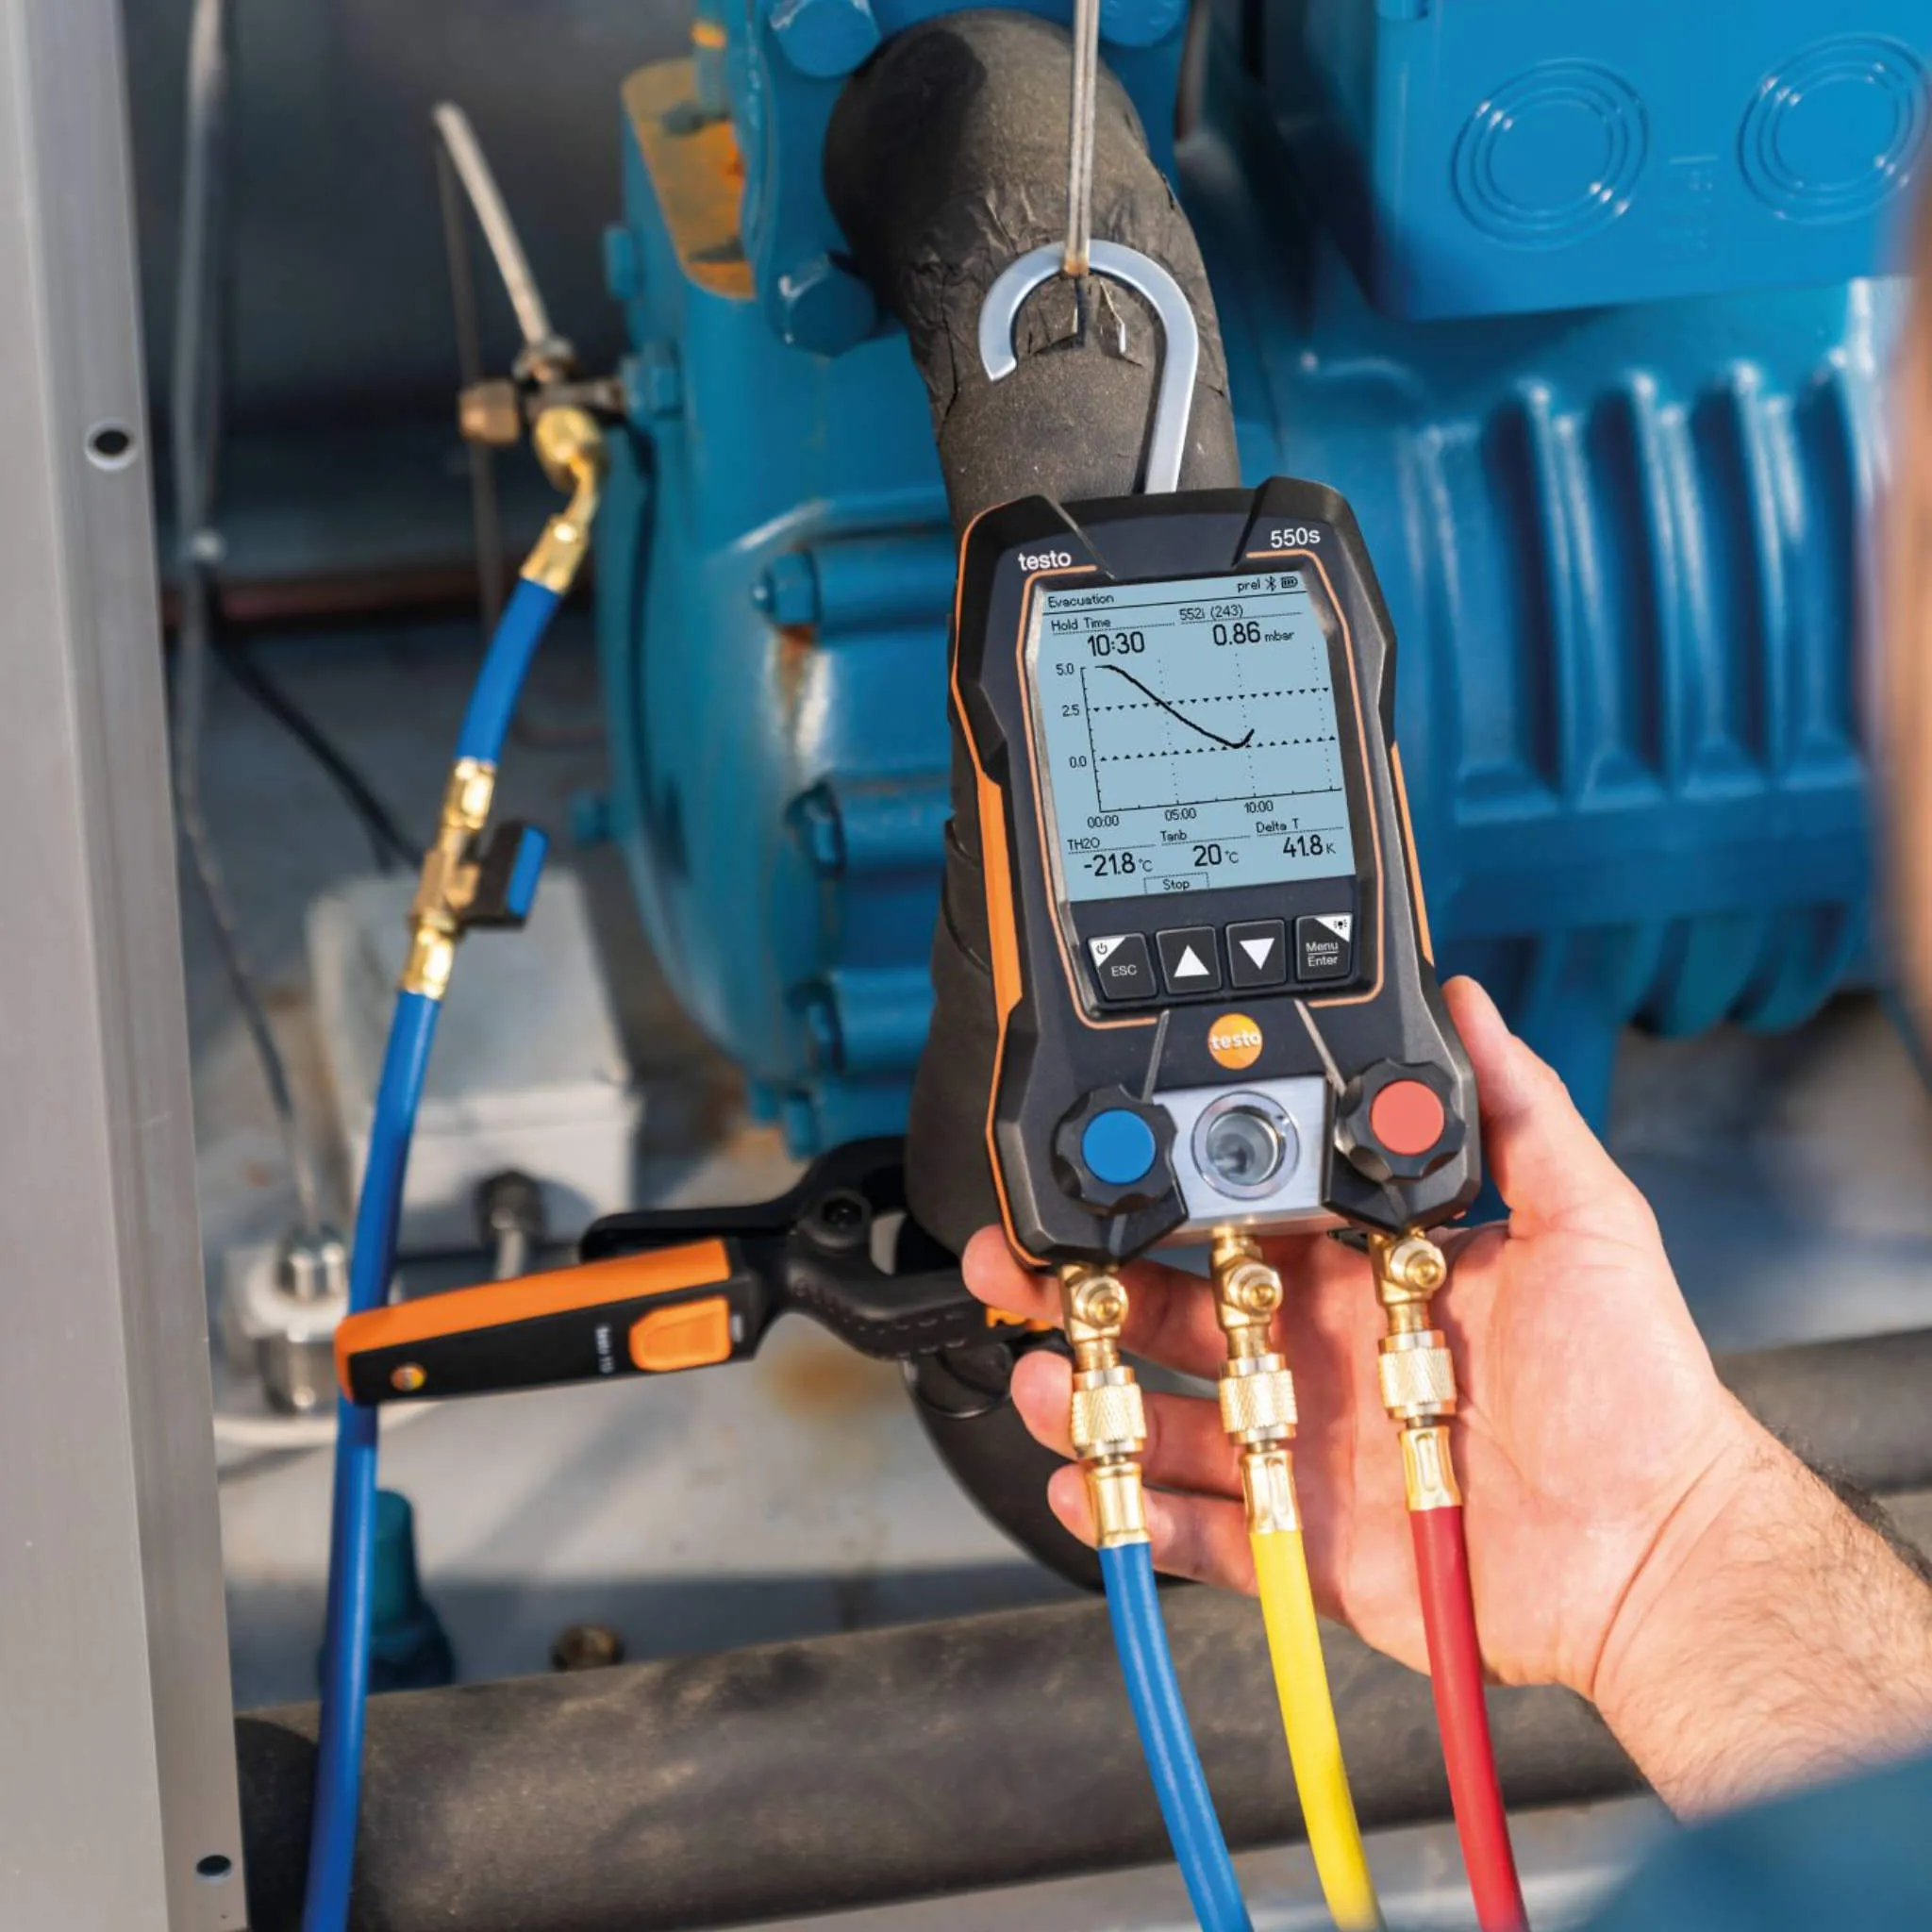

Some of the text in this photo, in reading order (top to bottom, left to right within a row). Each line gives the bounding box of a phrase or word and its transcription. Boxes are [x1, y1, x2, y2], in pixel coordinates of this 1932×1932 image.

[1270, 526, 1321, 548] 550s
[1018, 550, 1072, 572] testo
[1047, 594, 1115, 608] Evacuation
[1209, 604, 1243, 620] (243)
[1051, 617, 1111, 631] Hold Time
[1212, 621, 1295, 646] 0.86 mbar
[1087, 631, 1145, 657] 10:30
[1056, 662, 1074, 675] 5.0
[1062, 703, 1080, 717] 2.5
[1069, 756, 1088, 769] 0.0
[1244, 800, 1274, 814] 10:00
[1087, 814, 1120, 828] 00:00
[1164, 808, 1197, 822] 05:00
[1256, 818, 1299, 833] Delta T
[1283, 834, 1337, 858] 41.8 K
[1192, 844, 1223, 867] 20
[1084, 852, 1136, 876] -21.8
[1162, 879, 1191, 891] Stop
[1306, 941, 1339, 952] Menu
[1307, 955, 1339, 967] Enter
[1110, 964, 1138, 977] ESC
[1210, 1031, 1262, 1051] testo
